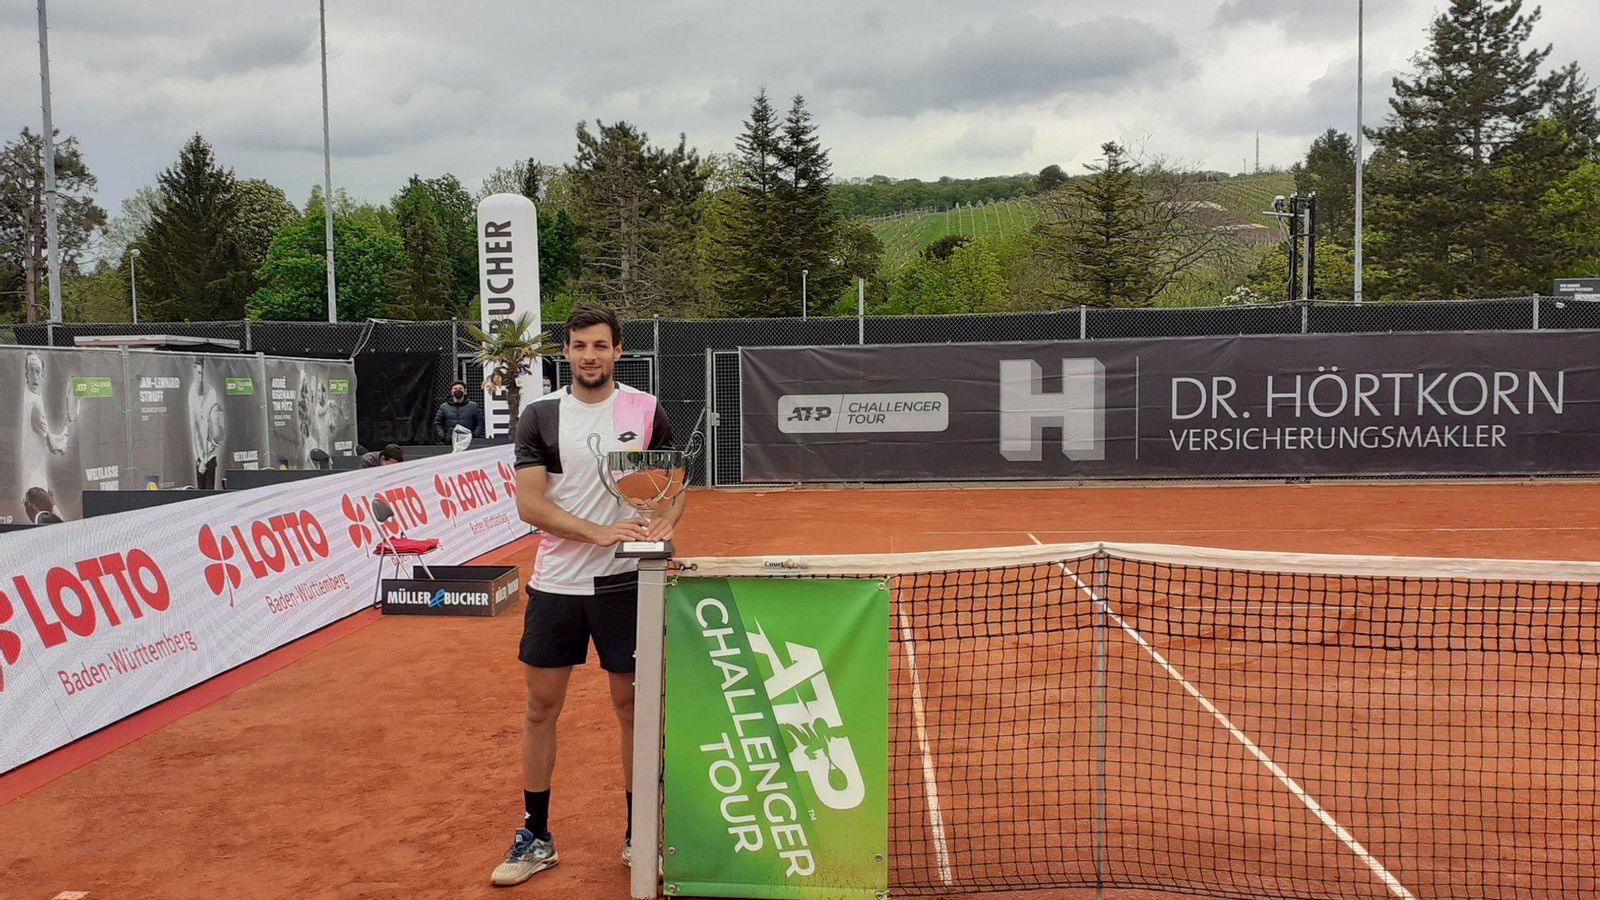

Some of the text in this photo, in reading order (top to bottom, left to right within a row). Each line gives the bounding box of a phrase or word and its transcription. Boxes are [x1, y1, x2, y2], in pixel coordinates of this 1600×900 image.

[787, 406, 832, 422] ATP
[848, 401, 942, 414] CHALLENGER
[1171, 366, 1564, 420] DR. HÖRTKORN
[848, 414, 886, 424] TOUR
[1169, 424, 1507, 452] VERSICHERUNGSMAKLER
[448, 469, 497, 512] LOTTO
[230, 510, 330, 579] LOTTO
[12, 548, 171, 649] LOTTO
[265, 573, 350, 614] Baden-Württemberg
[387, 588, 431, 605] MÜLLER
[443, 591, 489, 606] BUCHER
[57, 630, 198, 696] Baden-Württemberg
[746, 616, 866, 810] ATP
[695, 597, 815, 878] CHALLENGER
[700, 732, 764, 854] TOUR
